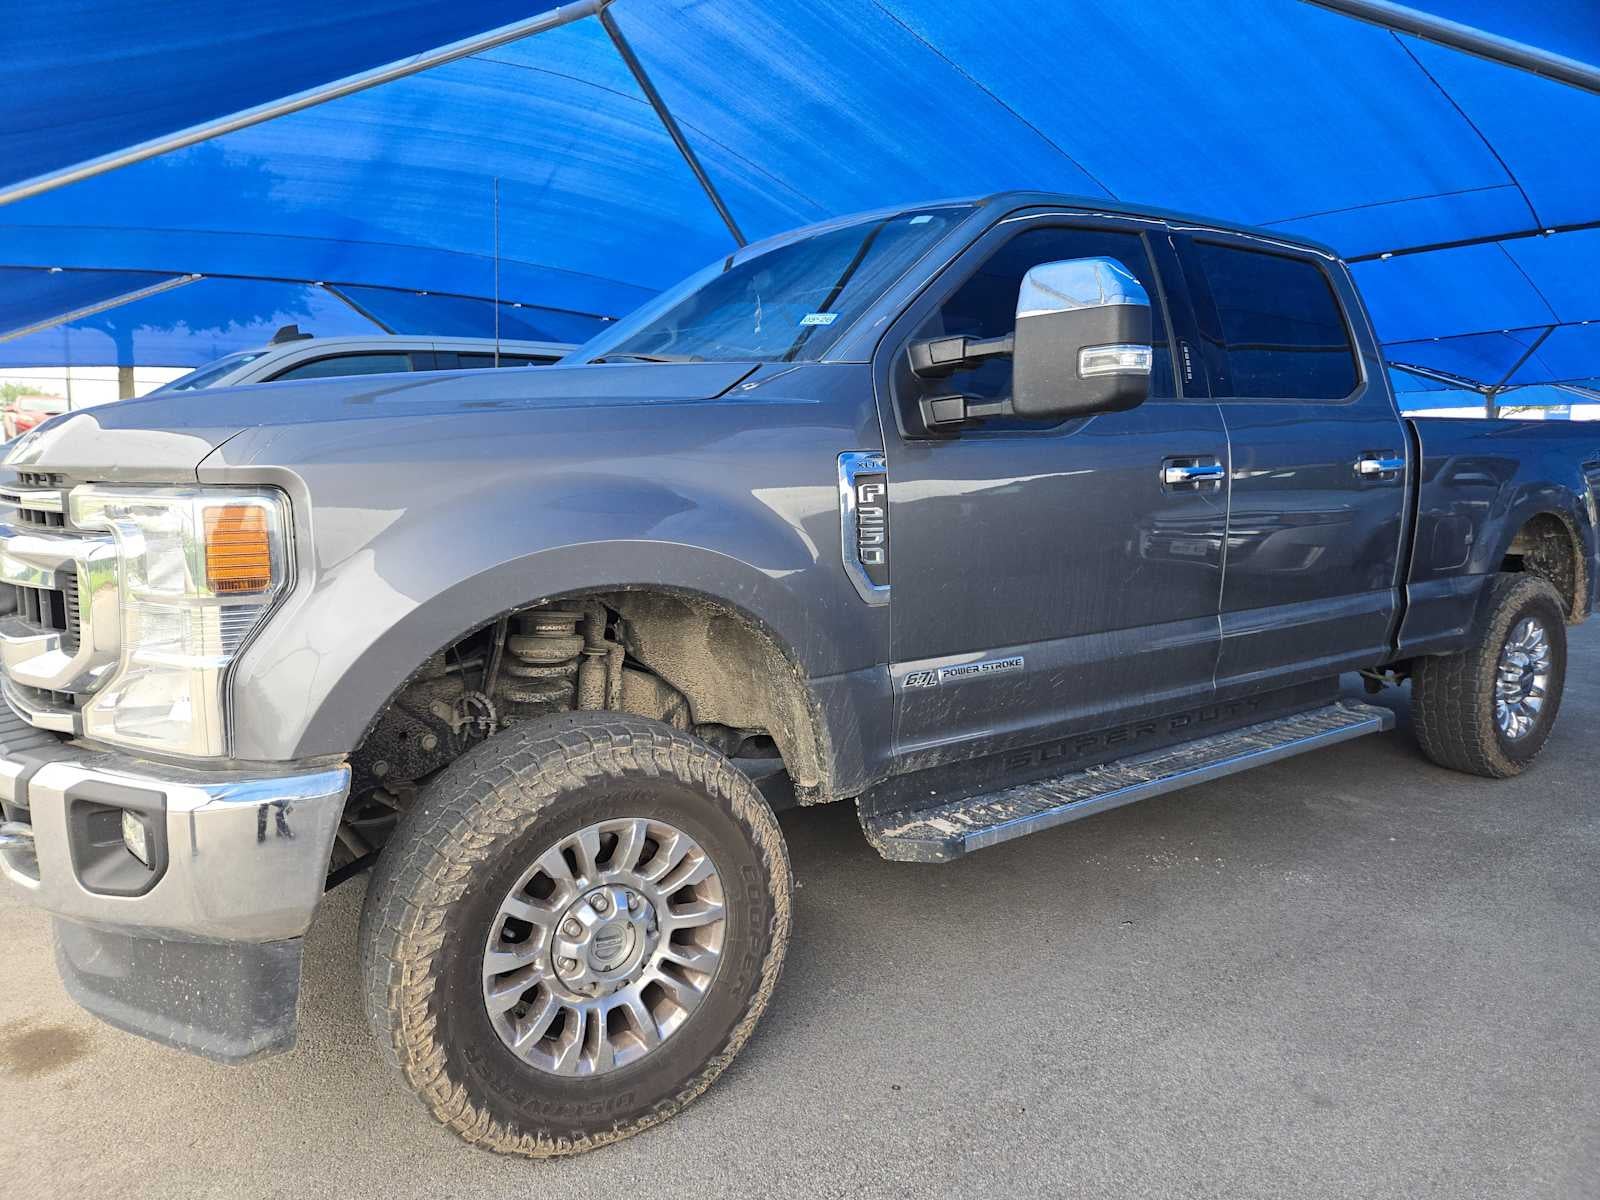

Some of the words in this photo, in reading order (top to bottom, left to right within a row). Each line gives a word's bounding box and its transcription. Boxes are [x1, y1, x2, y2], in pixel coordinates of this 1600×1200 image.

[858, 483, 885, 565] F250
[905, 671, 937, 687] 6.7L
[943, 664, 980, 678] POWER
[982, 658, 1022, 671] STROKE
[1007, 721, 1156, 769] SUPER
[1170, 698, 1261, 728] DUTY
